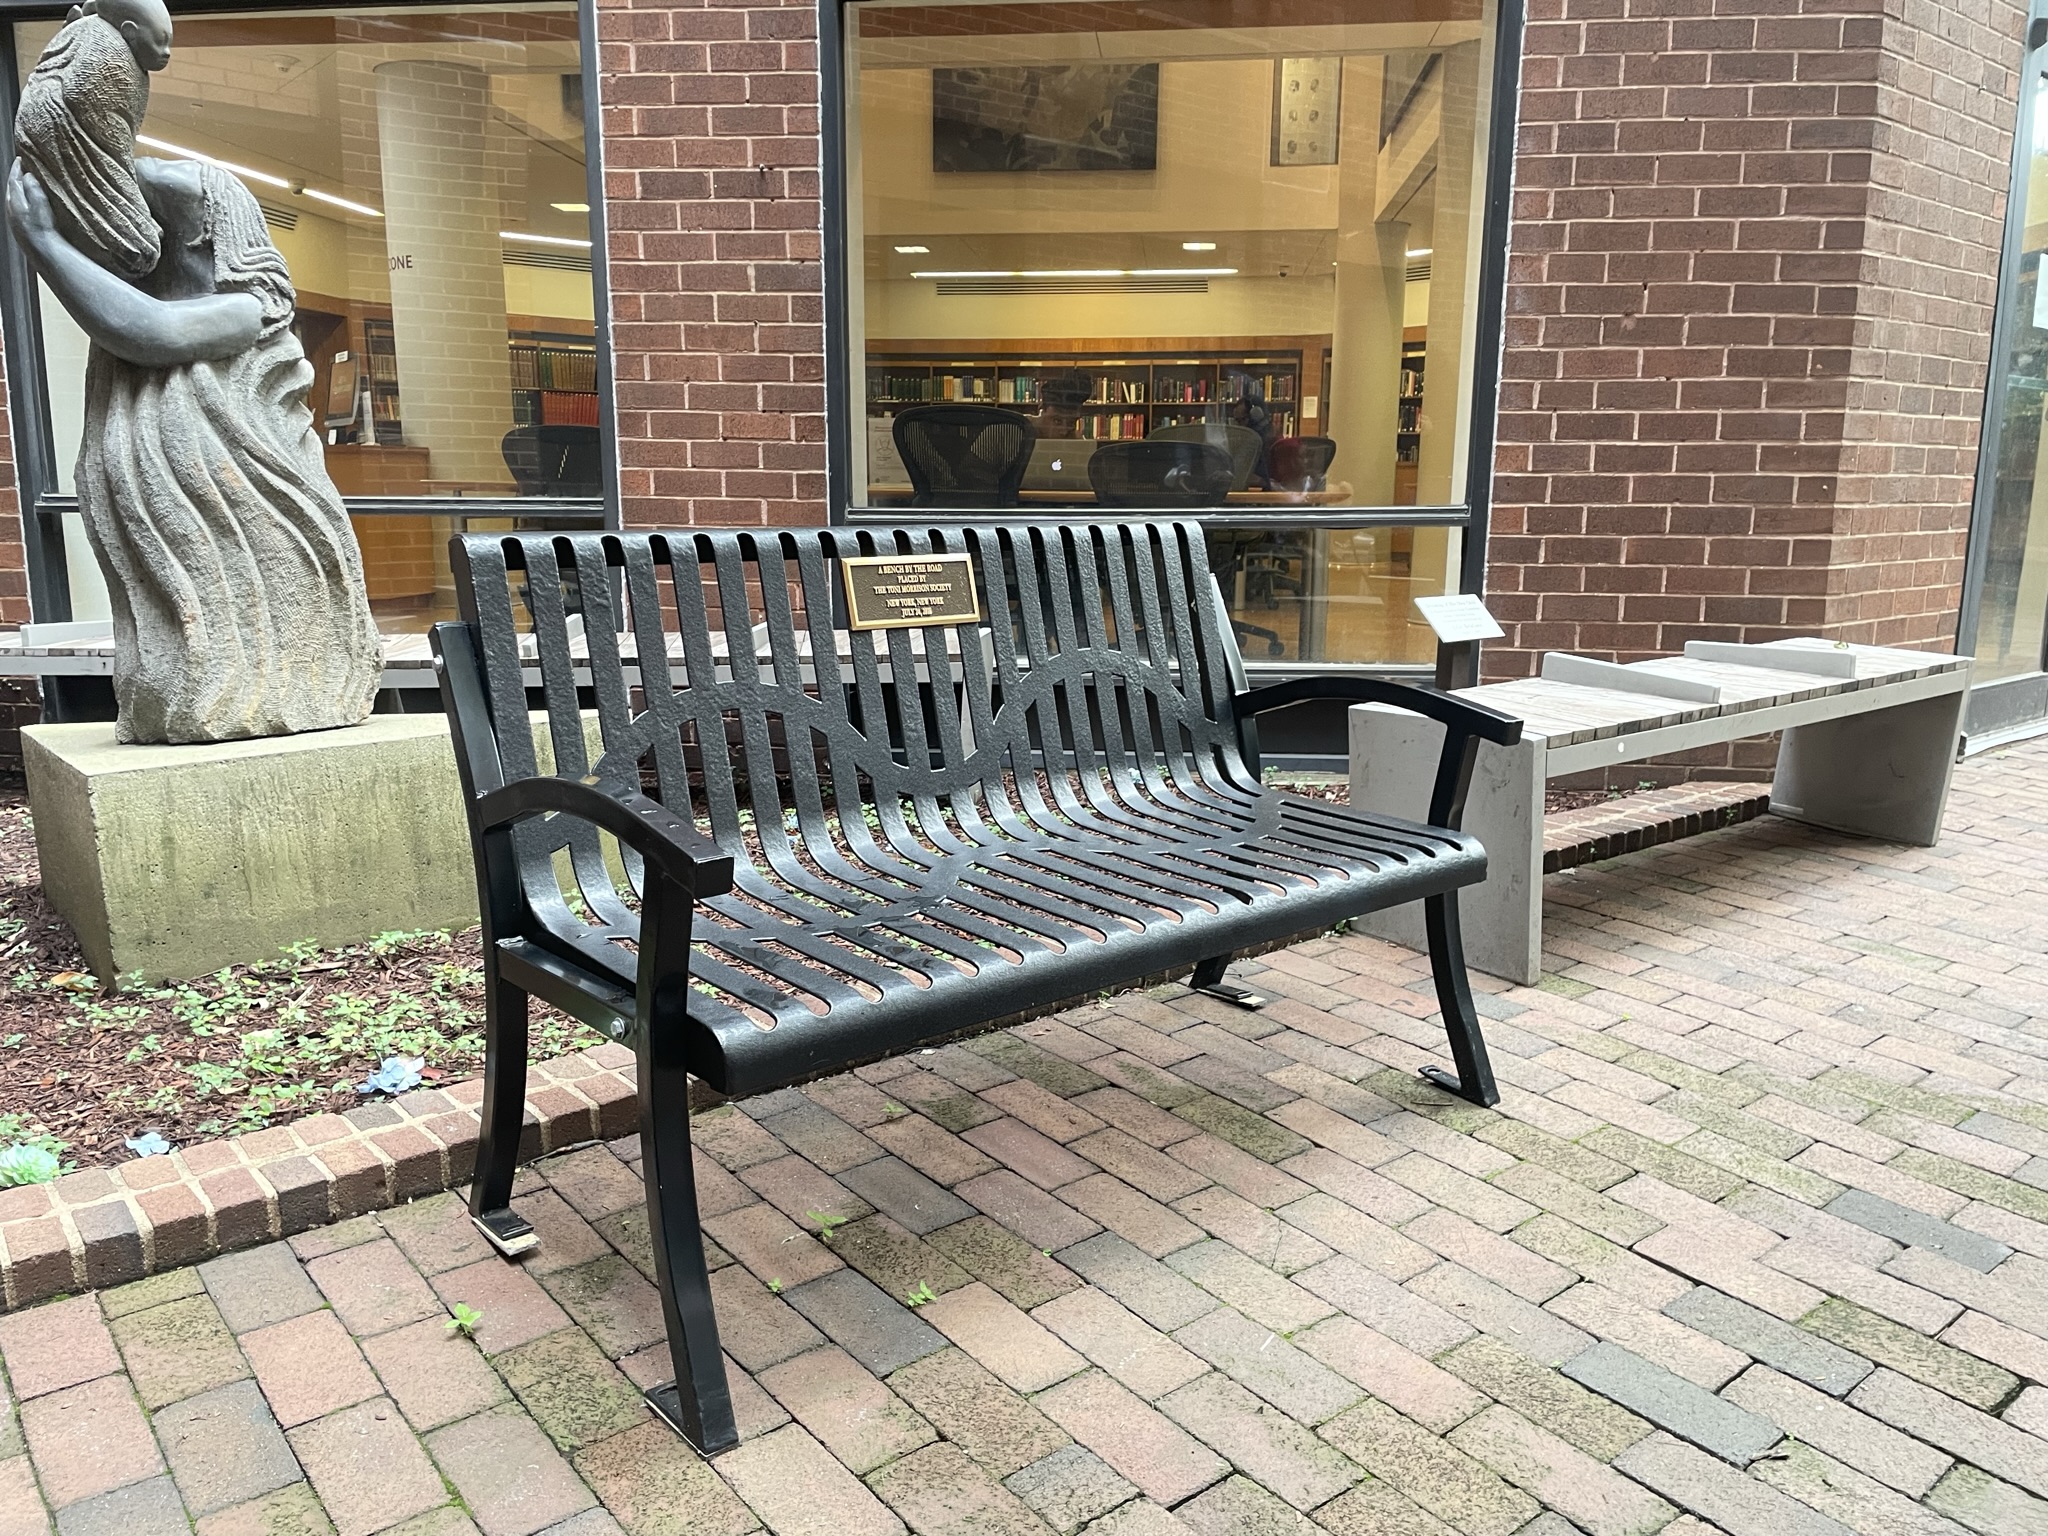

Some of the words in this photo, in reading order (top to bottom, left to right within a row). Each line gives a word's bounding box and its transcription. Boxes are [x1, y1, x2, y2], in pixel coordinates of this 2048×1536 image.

[389, 255, 413, 271] ONE
[878, 566, 883, 574] A
[883, 565, 904, 574] BENCH
[905, 564, 913, 573] BY
[913, 564, 926, 573] THE
[927, 564, 943, 572] ROAD
[897, 575, 919, 583] PLACED
[919, 575, 926, 583] BY
[873, 586, 887, 594] THE
[887, 586, 901, 594] TONI
[902, 584, 929, 593] MORRISON
[930, 583, 952, 592] SOCIETY
[886, 598, 899, 607] NEW
[899, 598, 916, 607] YORK,
[915, 597, 929, 606] NEW
[929, 596, 944, 605] YORK
[901, 608, 915, 618] JULY
